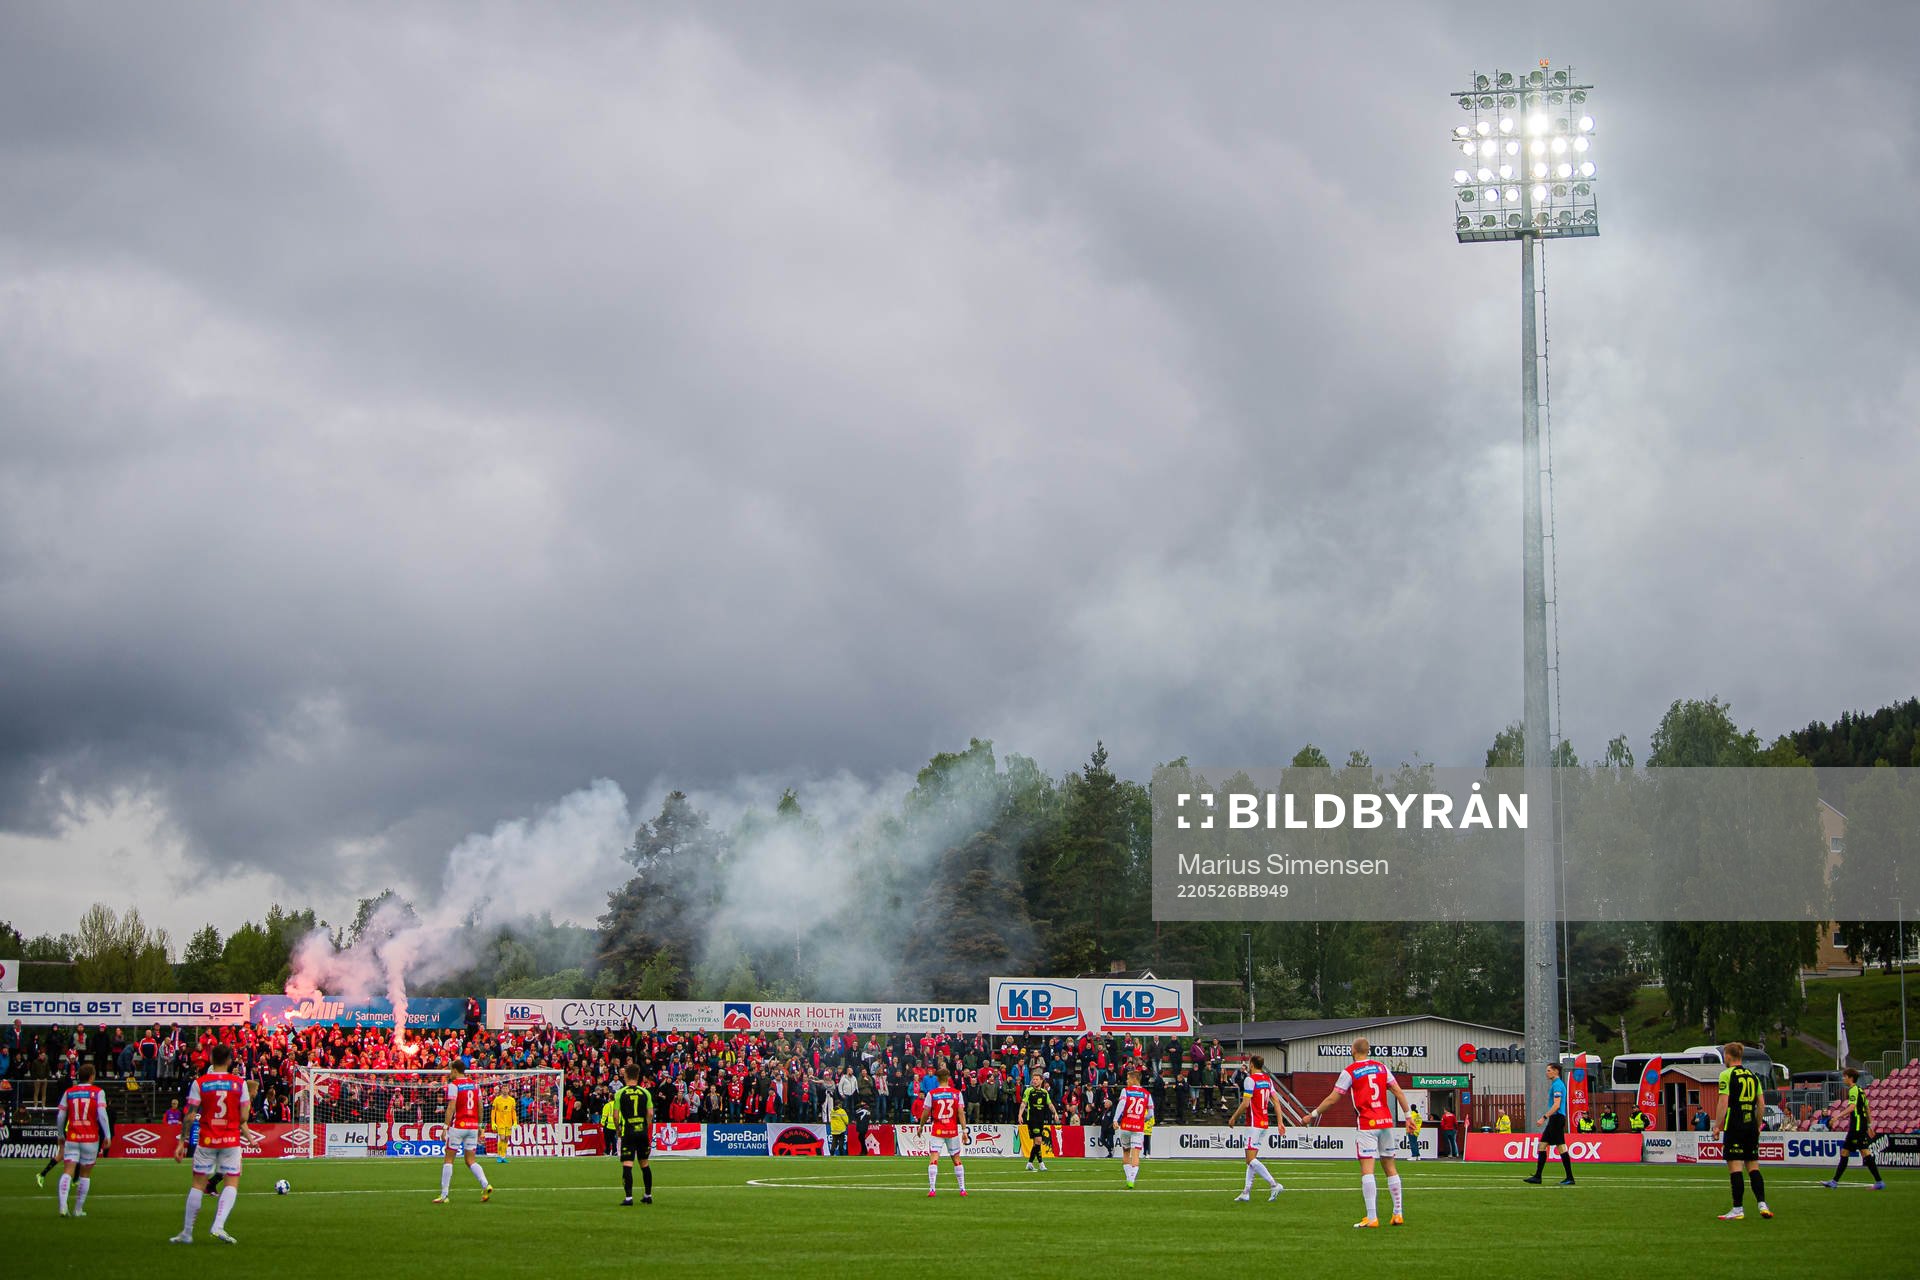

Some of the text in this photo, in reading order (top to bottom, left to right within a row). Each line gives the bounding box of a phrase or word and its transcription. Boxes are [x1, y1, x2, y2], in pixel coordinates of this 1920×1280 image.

[7, 1001, 122, 1013] BETONG ØST
[132, 1002, 244, 1013] BETONG ØST
[753, 1006, 844, 1018] GUNNAR HOLTH
[1008, 989, 1052, 1017] KB
[1112, 990, 1155, 1018] KB
[355, 1011, 395, 1021] Sammen
[431, 1012, 440, 1022] vi
[509, 1006, 530, 1020] KB
[561, 1002, 658, 1028] CASTRUM
[858, 1013, 882, 1021] KNUSTE
[1374, 1046, 1388, 1056] OG
[1391, 1046, 1409, 1056] BAD
[1412, 1047, 1424, 1056] AS
[1367, 1073, 1380, 1100] 5
[1738, 1076, 1756, 1102] 20
[72, 1098, 90, 1120] 17
[214, 1090, 228, 1119] 3
[466, 1090, 474, 1109] 8
[630, 1095, 639, 1117] 7
[937, 1099, 954, 1119] 23
[1127, 1096, 1144, 1115] 26
[507, 1122, 583, 1145] OKENDE
[1179, 1134, 1209, 1149] Glåm
[1268, 1135, 1344, 1149] Glåm dalen
[1646, 1139, 1672, 1147] MAXBO
[240, 1146, 262, 1154] mbro
[284, 1146, 311, 1154] umbr
[1503, 1137, 1602, 1159] altbox
